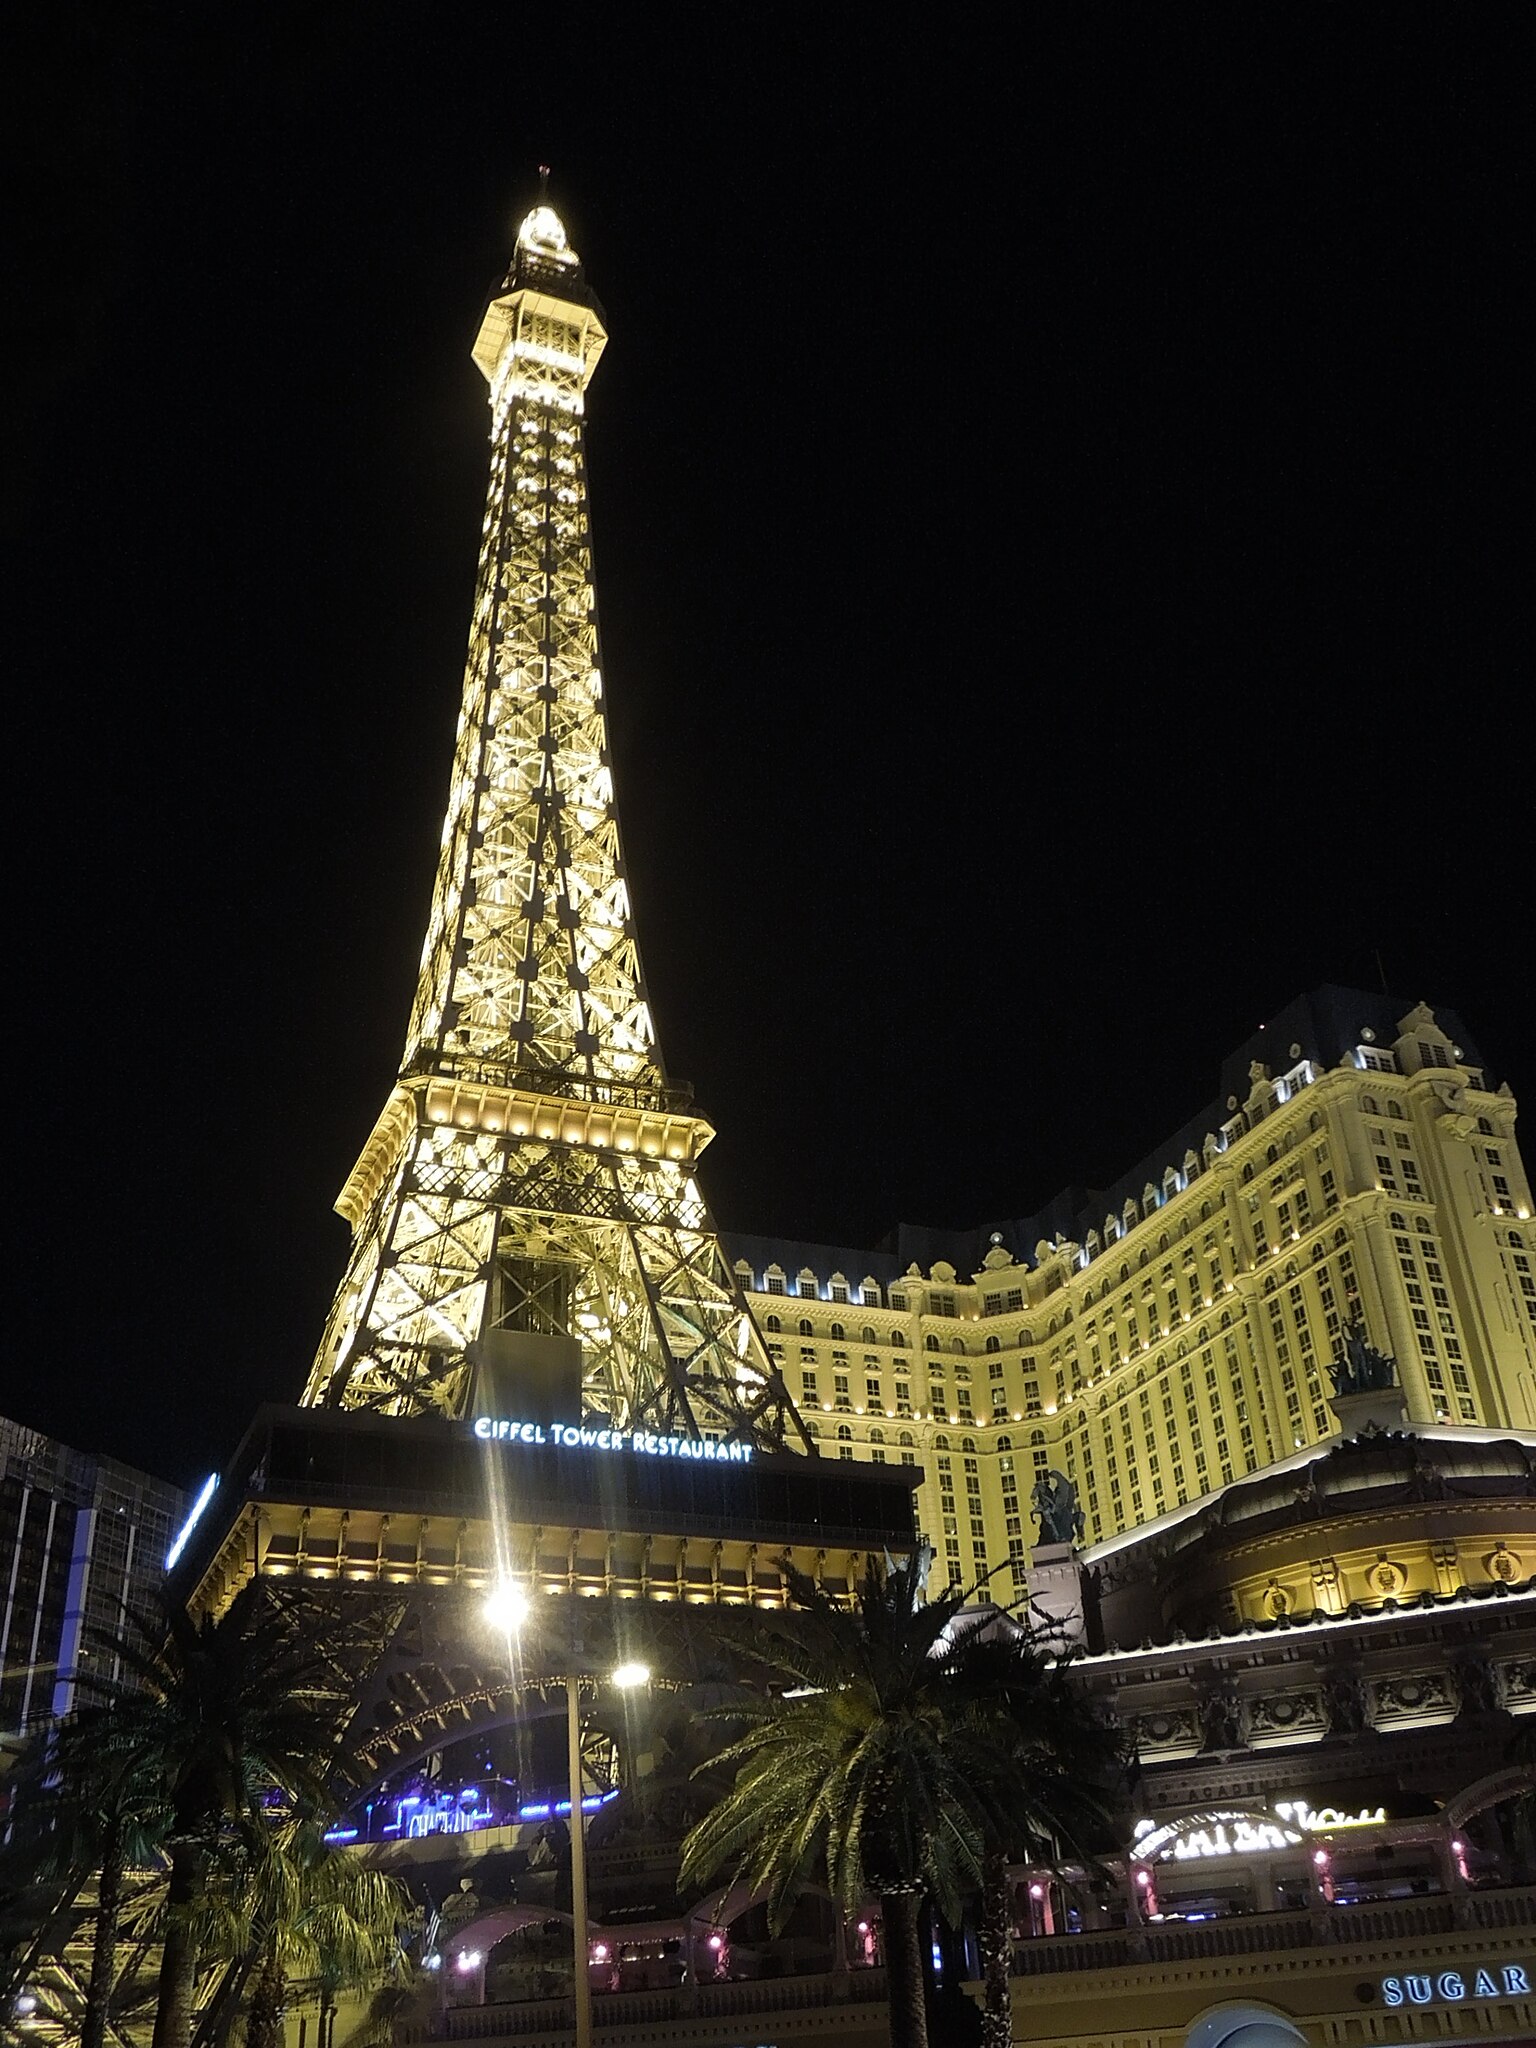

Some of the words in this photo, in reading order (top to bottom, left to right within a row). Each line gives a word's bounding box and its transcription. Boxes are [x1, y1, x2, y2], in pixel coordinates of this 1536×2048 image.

[475, 1417, 546, 1444] EIFFEL
[551, 1423, 623, 1450] TOWER
[632, 1432, 752, 1462] RESTAURANT
[1382, 1966, 1530, 2007] SUGAR
